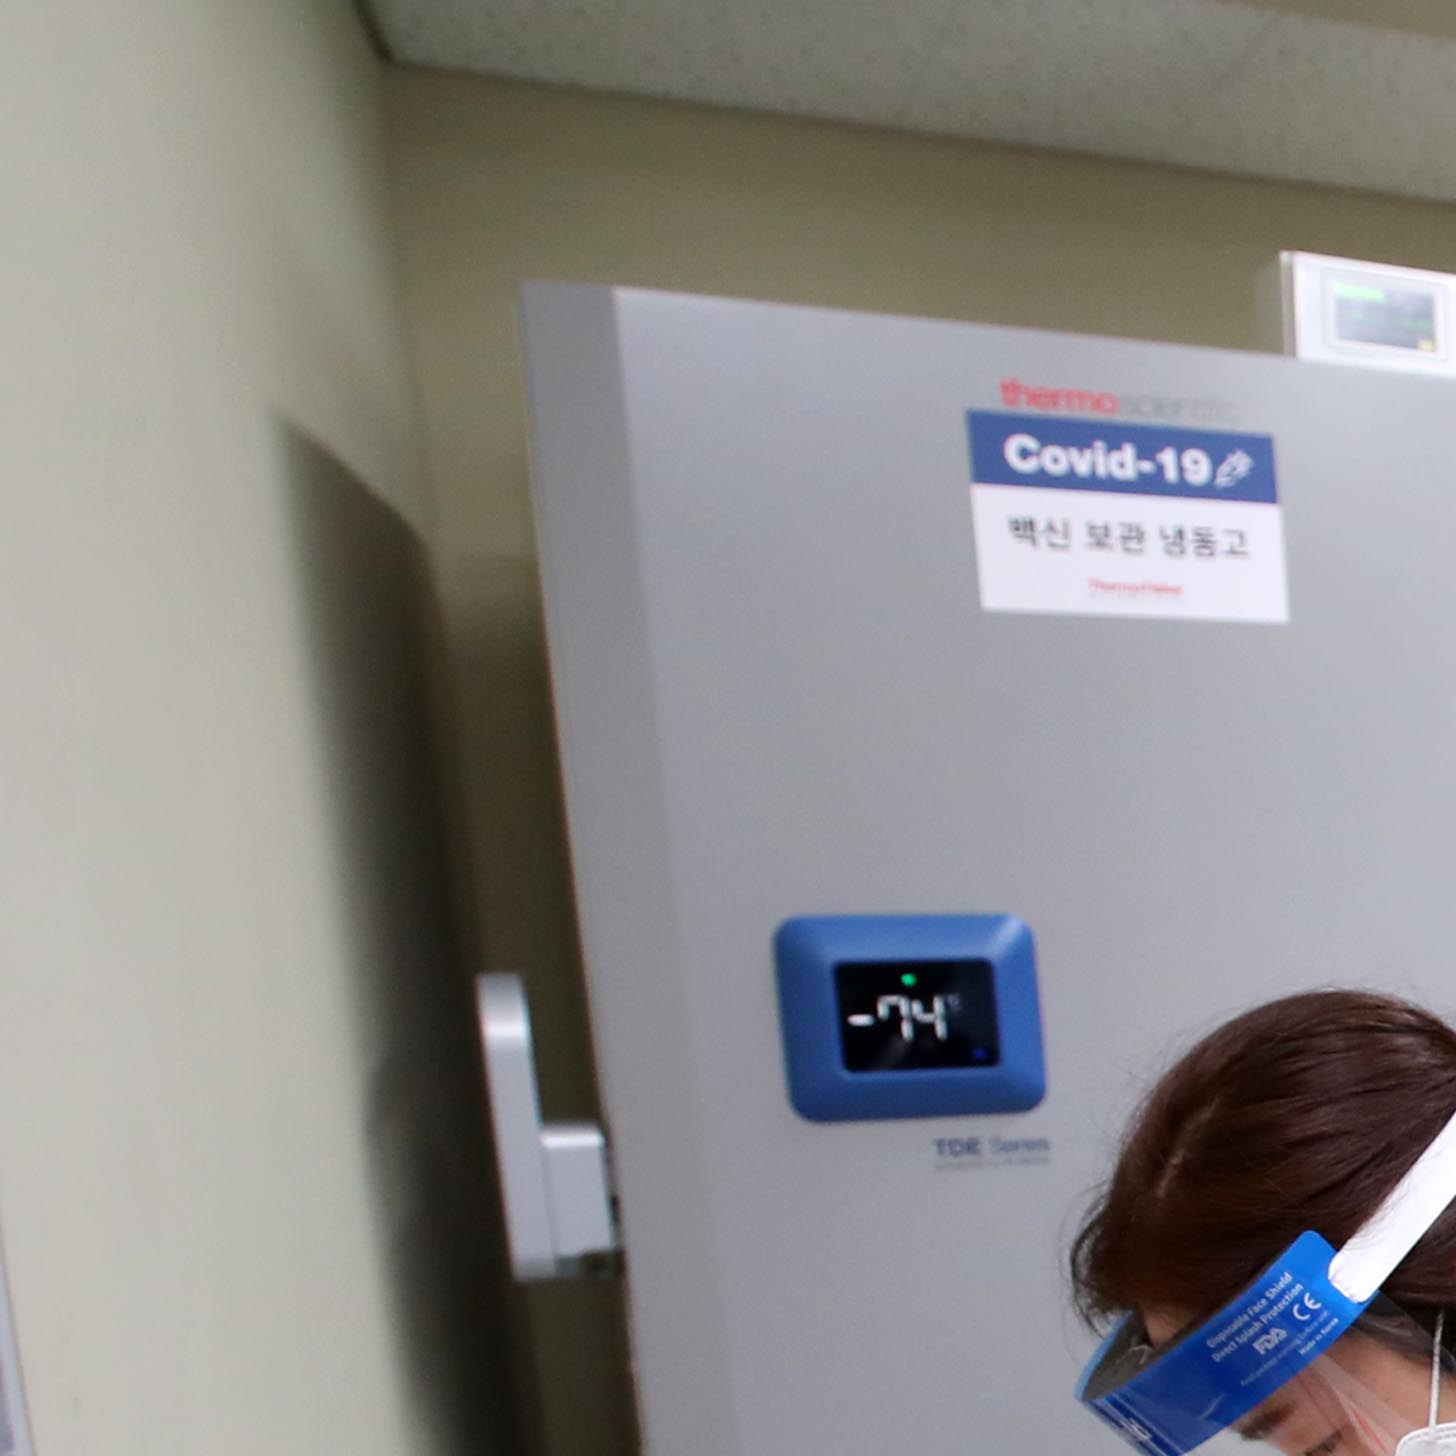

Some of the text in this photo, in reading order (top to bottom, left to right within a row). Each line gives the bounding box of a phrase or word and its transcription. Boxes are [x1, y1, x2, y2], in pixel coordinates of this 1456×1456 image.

[1003, 433, 1213, 487] Covid-19
[1007, 515, 1250, 559] 백신 보관 냉동고
[847, 994, 948, 1042] -74
[1206, 1271, 1293, 1348] Disposable Face Shield
[1211, 1283, 1304, 1363] Direct Splash Protection
[1252, 1327, 1288, 1355] FDA
[1292, 1292, 1322, 1321] CE
